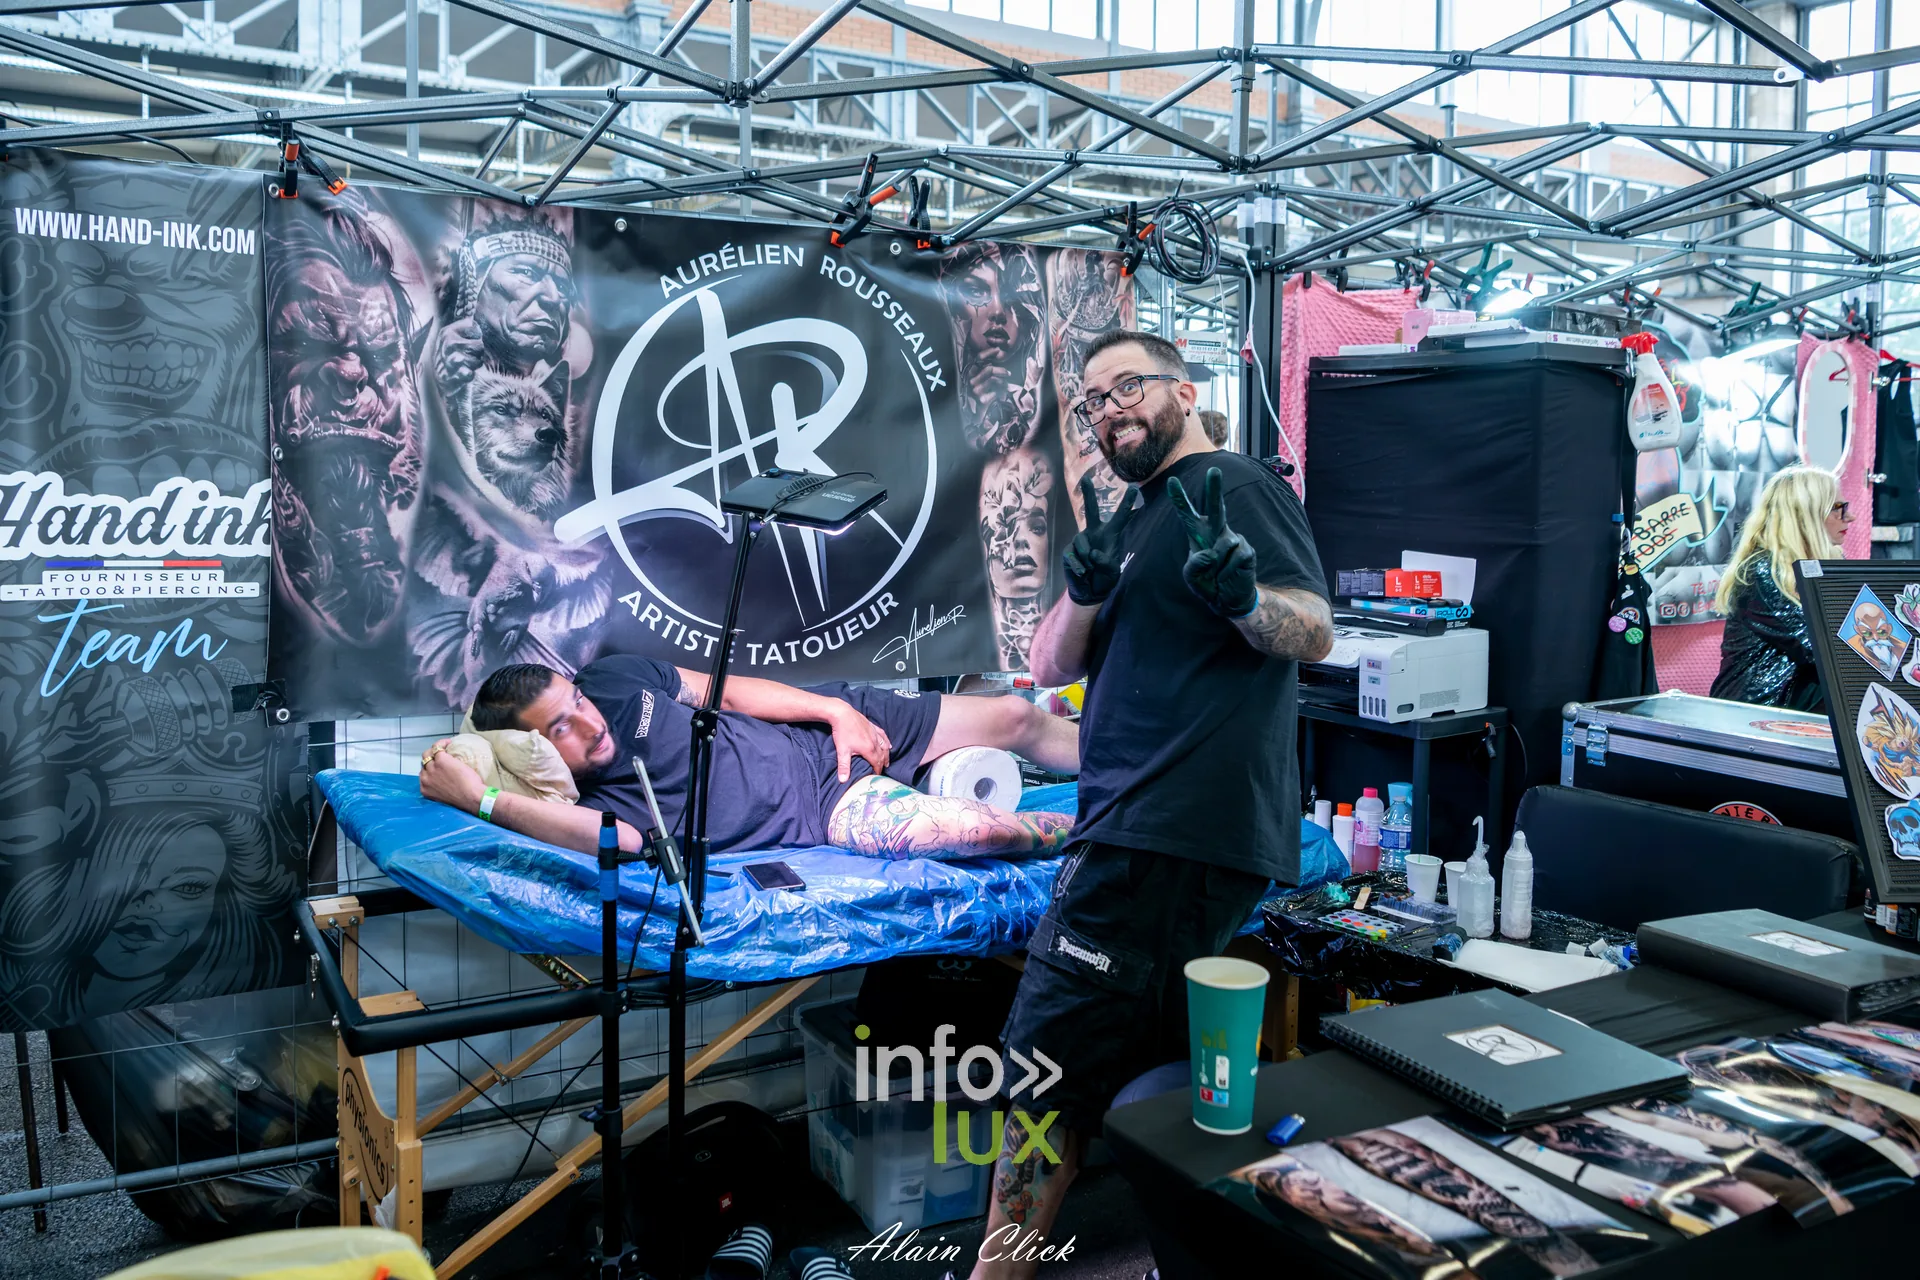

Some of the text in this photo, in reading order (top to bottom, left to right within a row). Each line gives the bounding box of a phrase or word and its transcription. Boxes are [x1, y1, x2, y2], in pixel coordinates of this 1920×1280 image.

[14, 207, 256, 255] WWW.HAND-INK.COM
[659, 244, 947, 392] AURÉLIEN ROUSSEAUX
[49, 573, 218, 583] FOURNISSEUR
[37, 598, 228, 697] team
[746, 591, 900, 666] TATOUEUR
[345, 1081, 385, 1185] physionics
